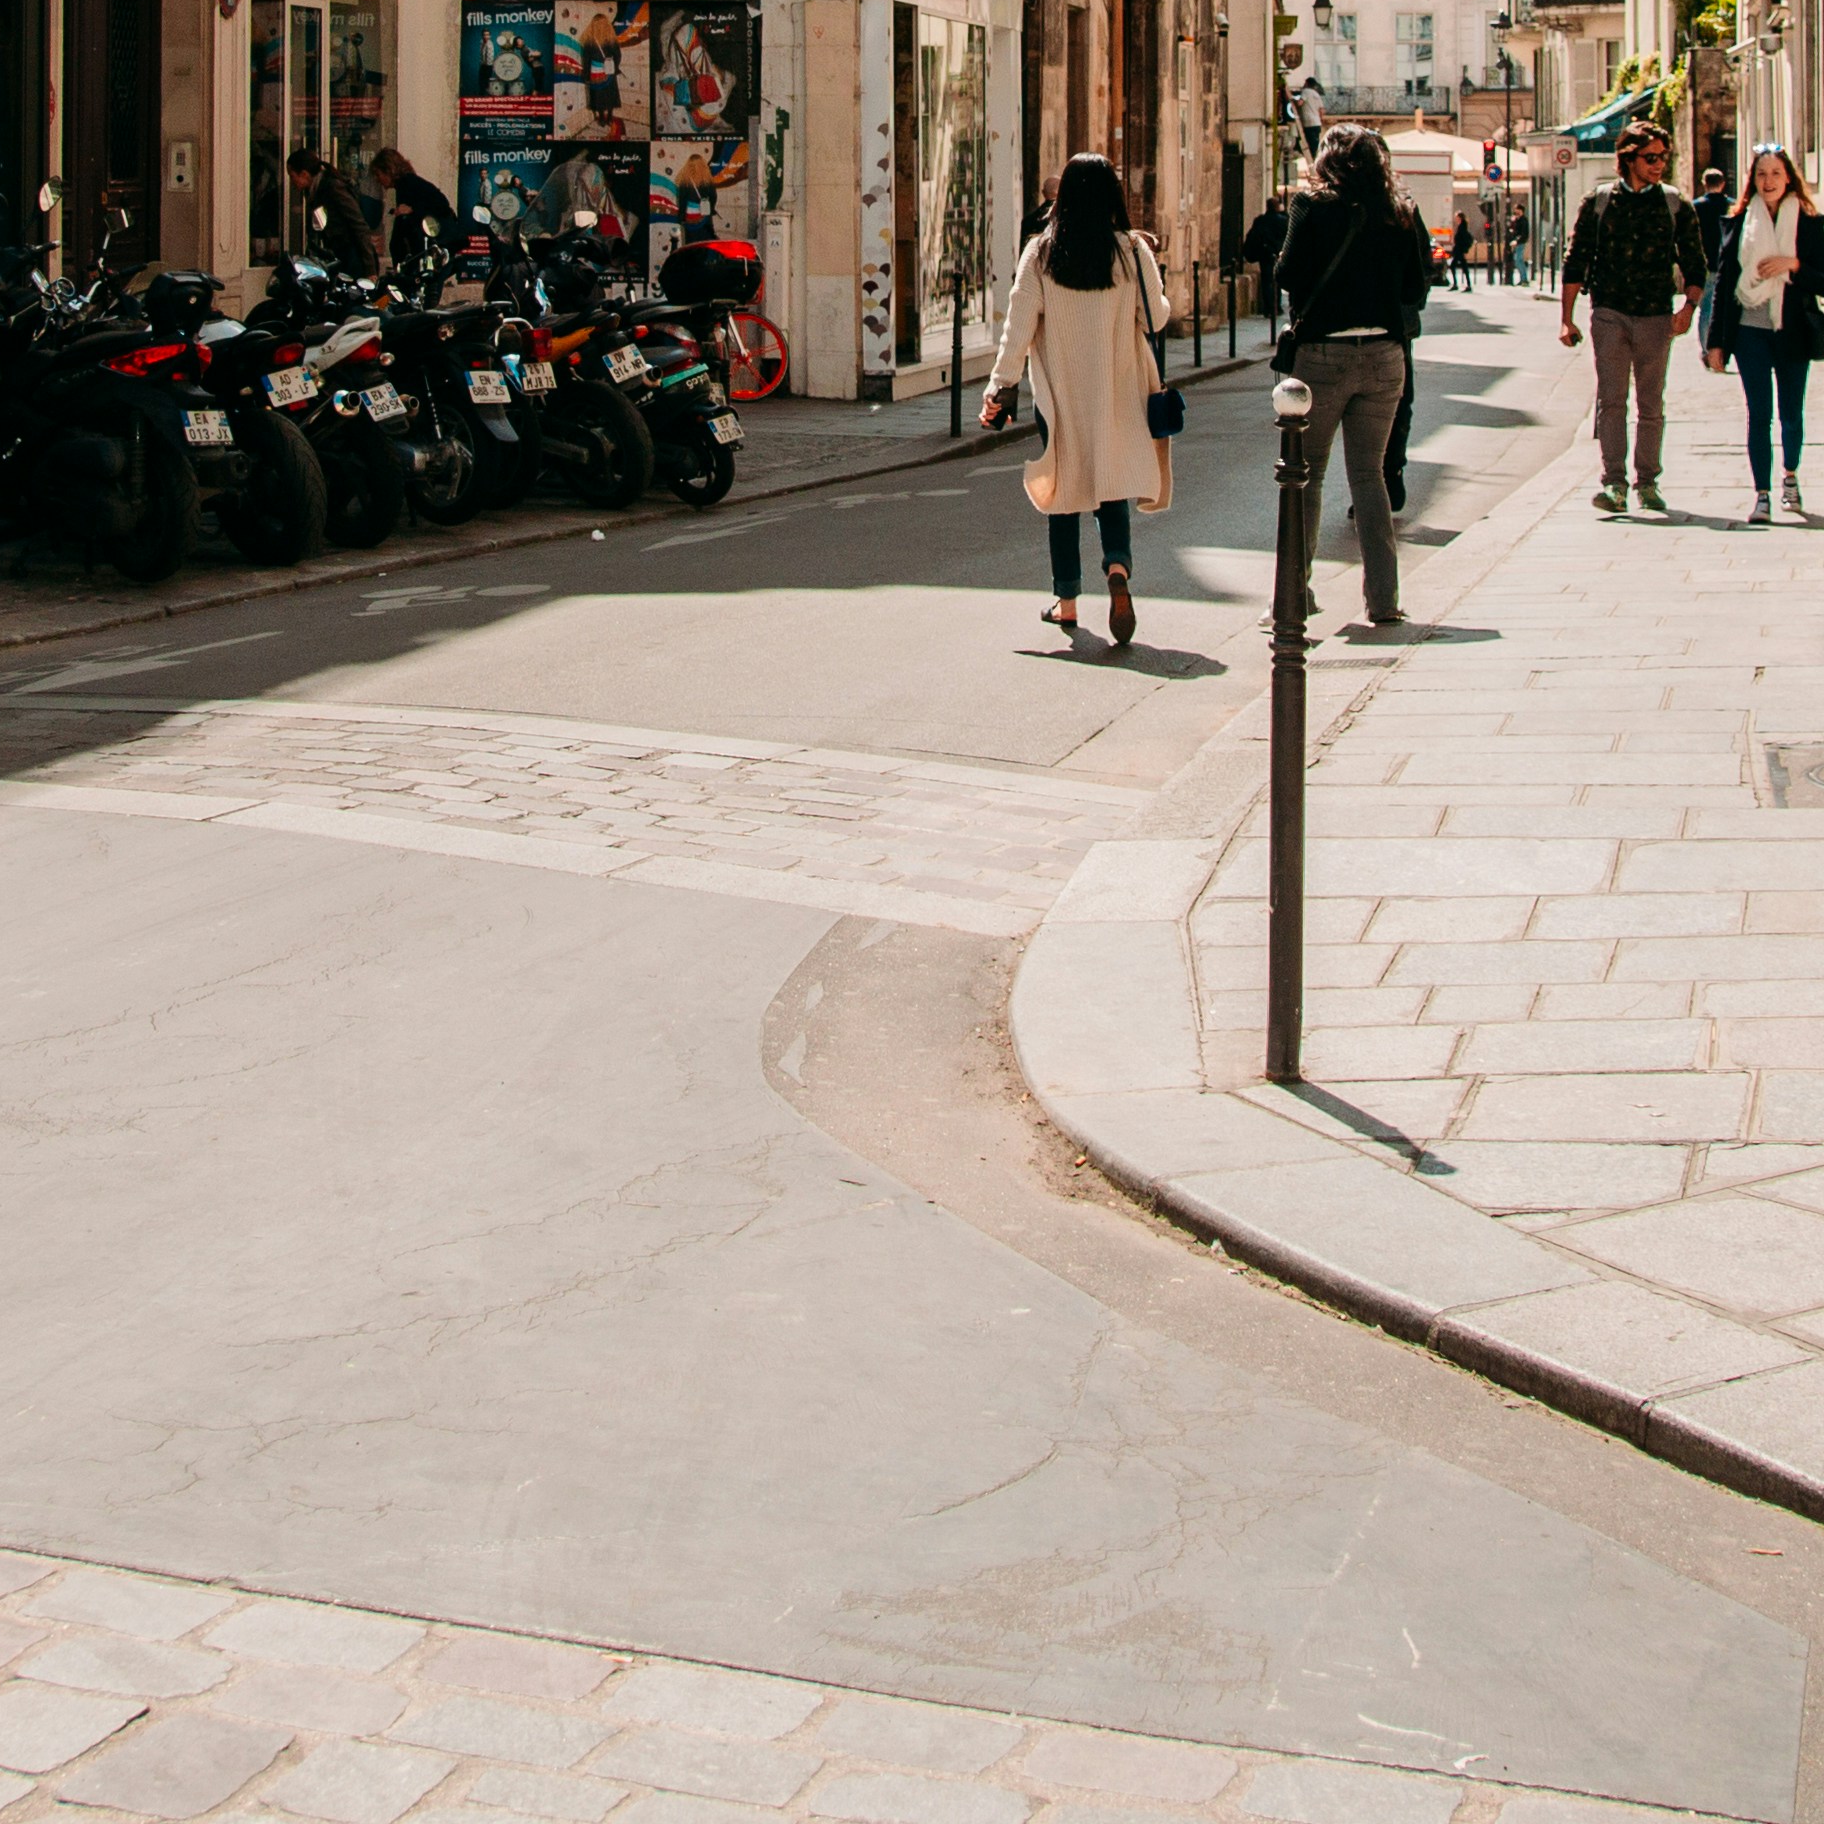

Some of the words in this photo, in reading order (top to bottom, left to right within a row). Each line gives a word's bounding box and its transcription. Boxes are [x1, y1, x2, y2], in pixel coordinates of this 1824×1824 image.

[466, 10, 493, 27] fills
[495, 7, 554, 25] monkey
[463, 149, 490, 165] fills
[493, 148, 552, 163] monkey
[194, 413, 209, 425] EA
